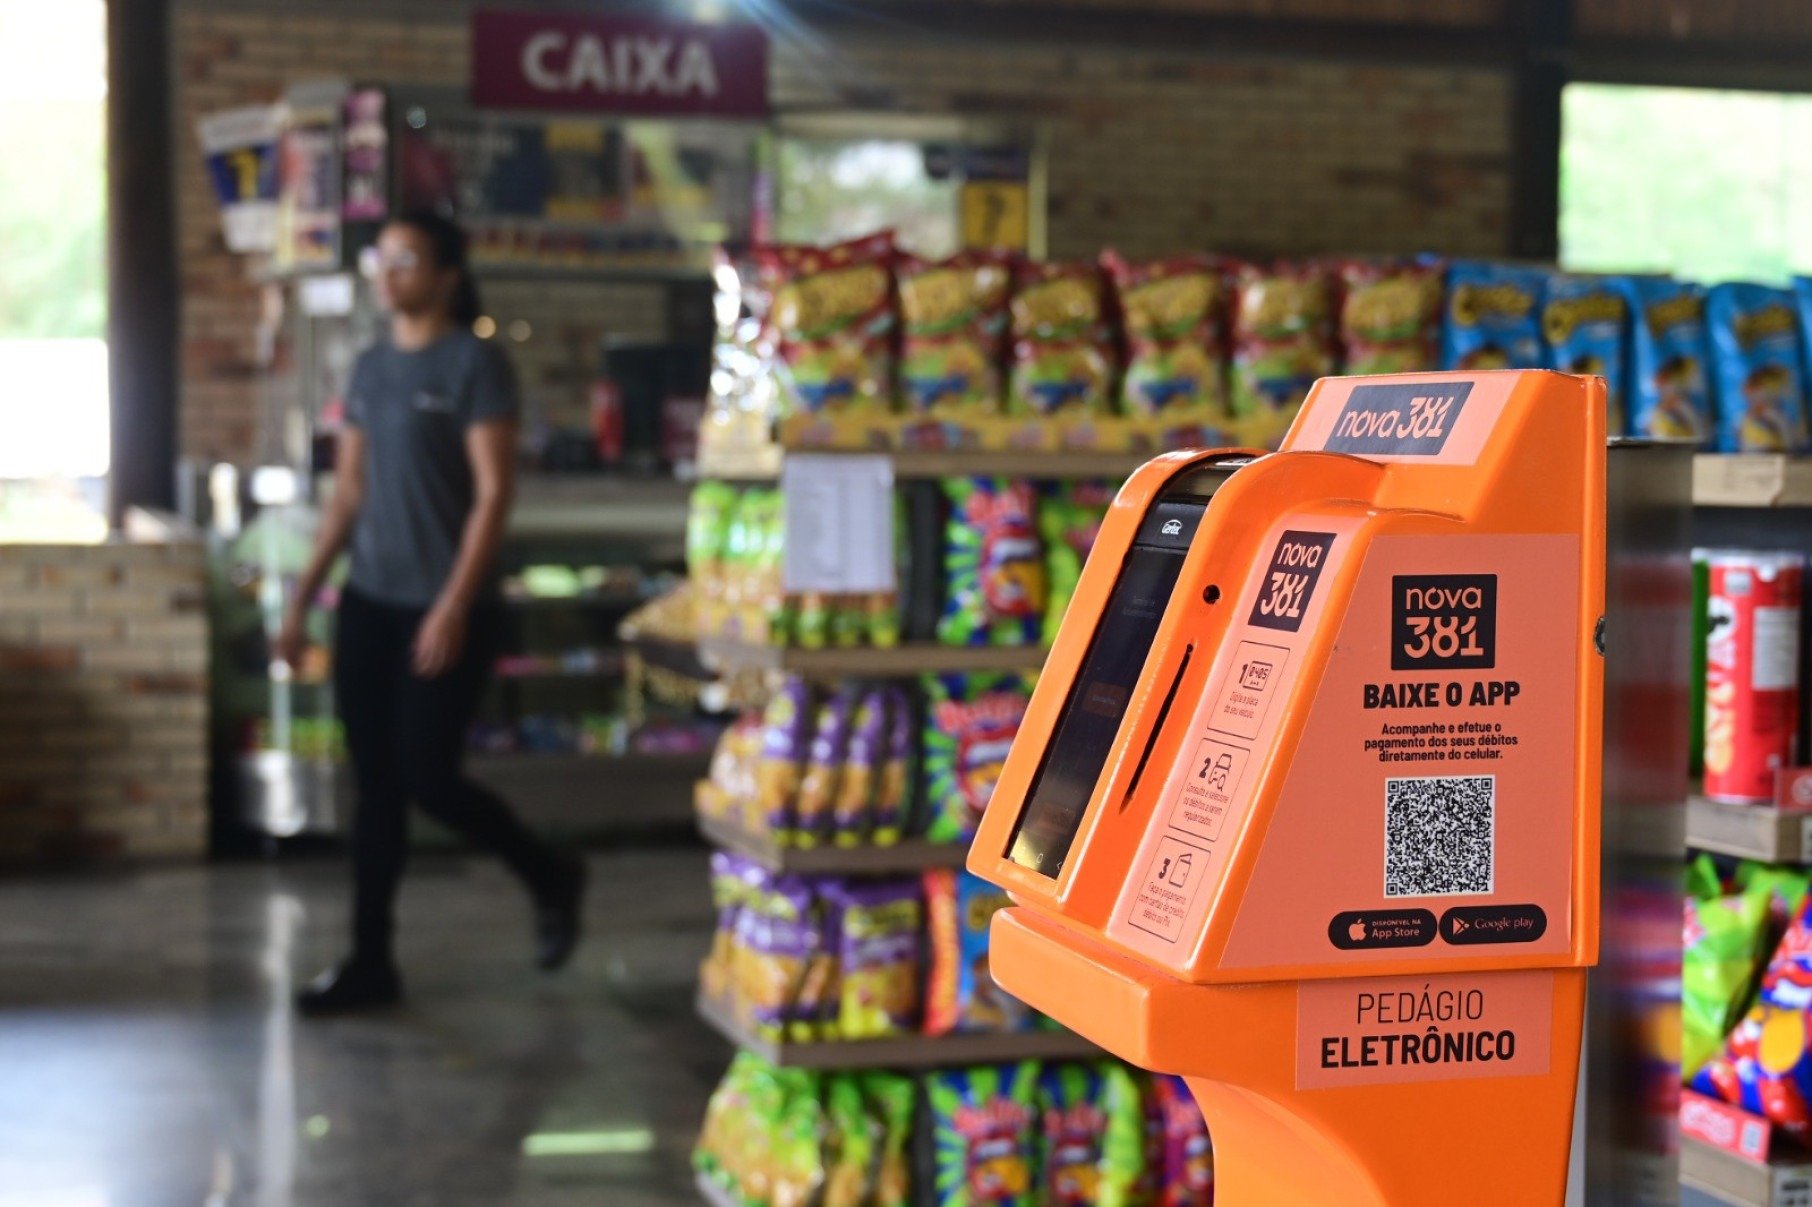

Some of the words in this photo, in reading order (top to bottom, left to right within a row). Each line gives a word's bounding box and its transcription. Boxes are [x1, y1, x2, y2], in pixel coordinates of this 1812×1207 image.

[521, 30, 720, 97] CAIXA
[1337, 409, 1400, 438] nova
[1396, 397, 1455, 438] 381
[1277, 542, 1322, 568] nova
[1260, 572, 1309, 618] 381
[1406, 586, 1482, 610] nova
[1404, 616, 1484, 658] 381
[1239, 664, 1248, 684] 1
[1364, 683, 1440, 709] BAIXE
[1446, 682, 1462, 707] O
[1469, 681, 1520, 706] APP
[1382, 722, 1445, 736] Acompanhe
[1448, 724, 1454, 733] e
[1458, 722, 1492, 733] efetue
[1494, 724, 1502, 732] o
[1364, 736, 1425, 750] pagamento
[1428, 736, 1447, 747] dos
[1450, 737, 1475, 746] seus
[1478, 734, 1518, 746] débitos
[1379, 750, 1445, 762] diretamente
[1448, 749, 1460, 760] do
[1464, 748, 1503, 760] celular.
[1199, 757, 1212, 778] 2
[1158, 858, 1171, 879] 3
[1372, 928, 1392, 940] App
[1394, 927, 1420, 938] Store
[1475, 916, 1512, 932] Google
[1514, 916, 1534, 929] play
[1357, 984, 1483, 1024] PEDÁGIO
[1322, 1026, 1514, 1068] ELETRÔNICO
